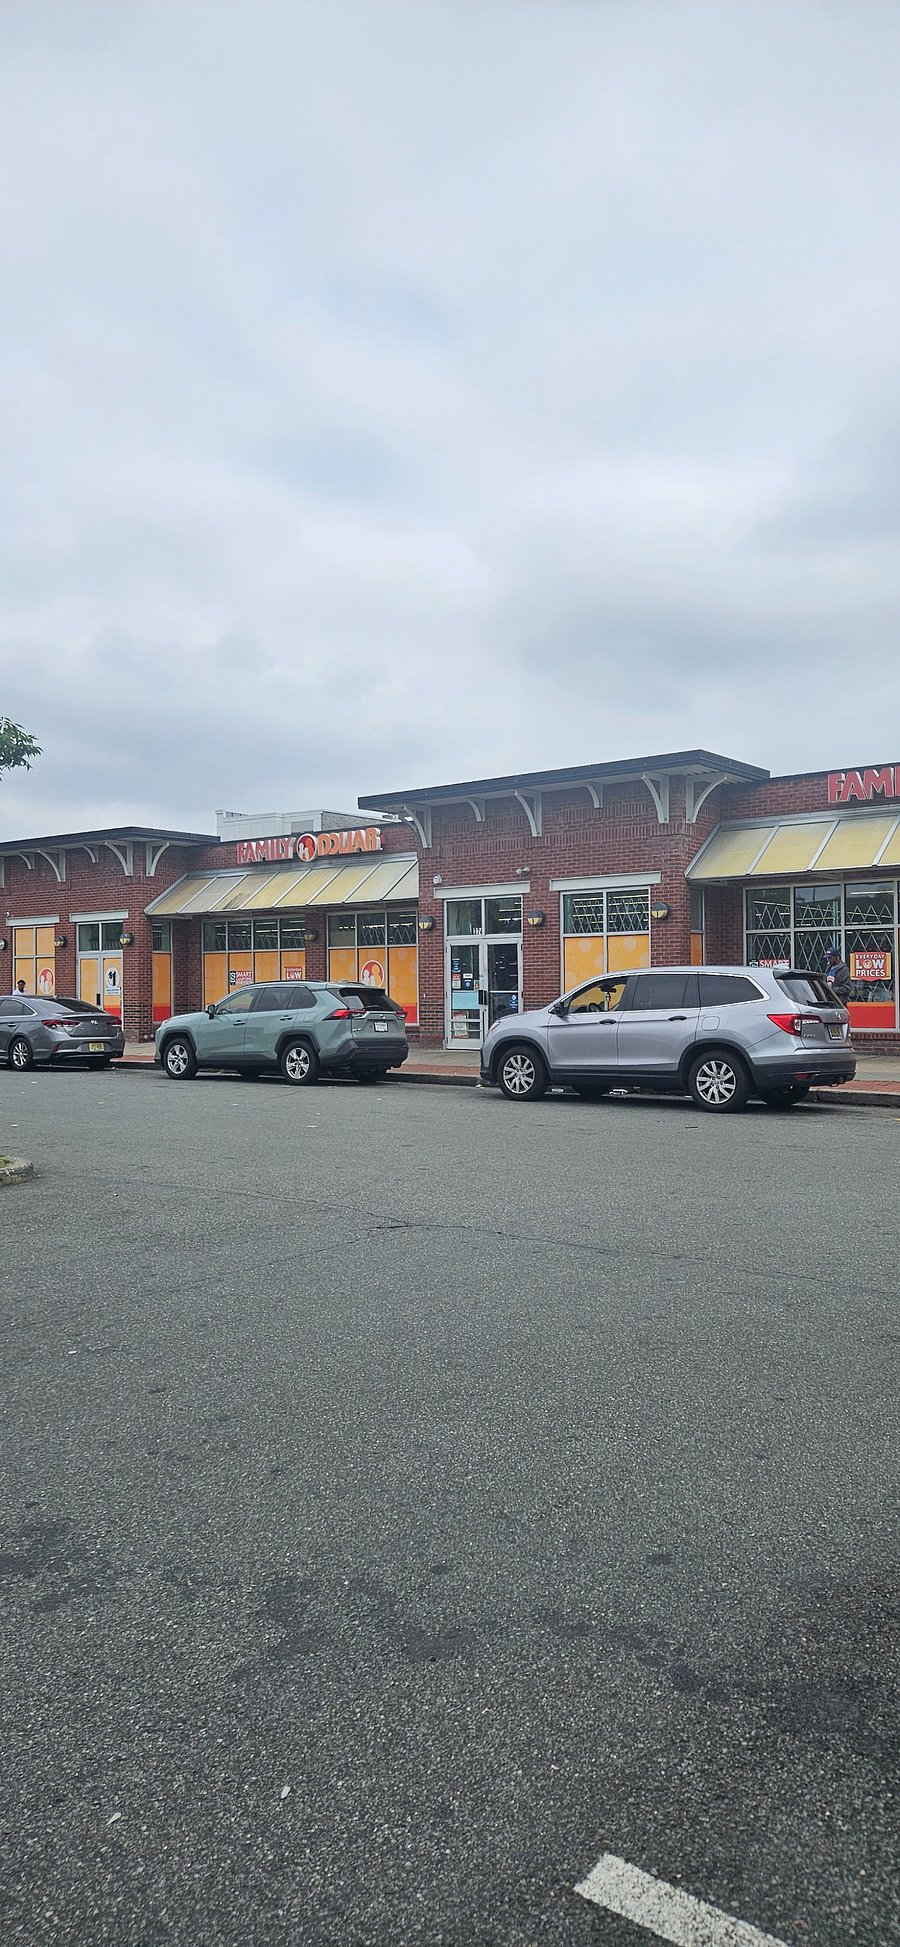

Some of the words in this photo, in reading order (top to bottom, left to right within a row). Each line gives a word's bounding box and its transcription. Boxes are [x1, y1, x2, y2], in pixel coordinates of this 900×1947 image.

[237, 837, 295, 864] FAMILY
[317, 827, 381, 857] DOLLAR
[855, 959, 885, 969] LOW
[108, 970, 117, 987] $1
[855, 969, 886, 977] PRICES
